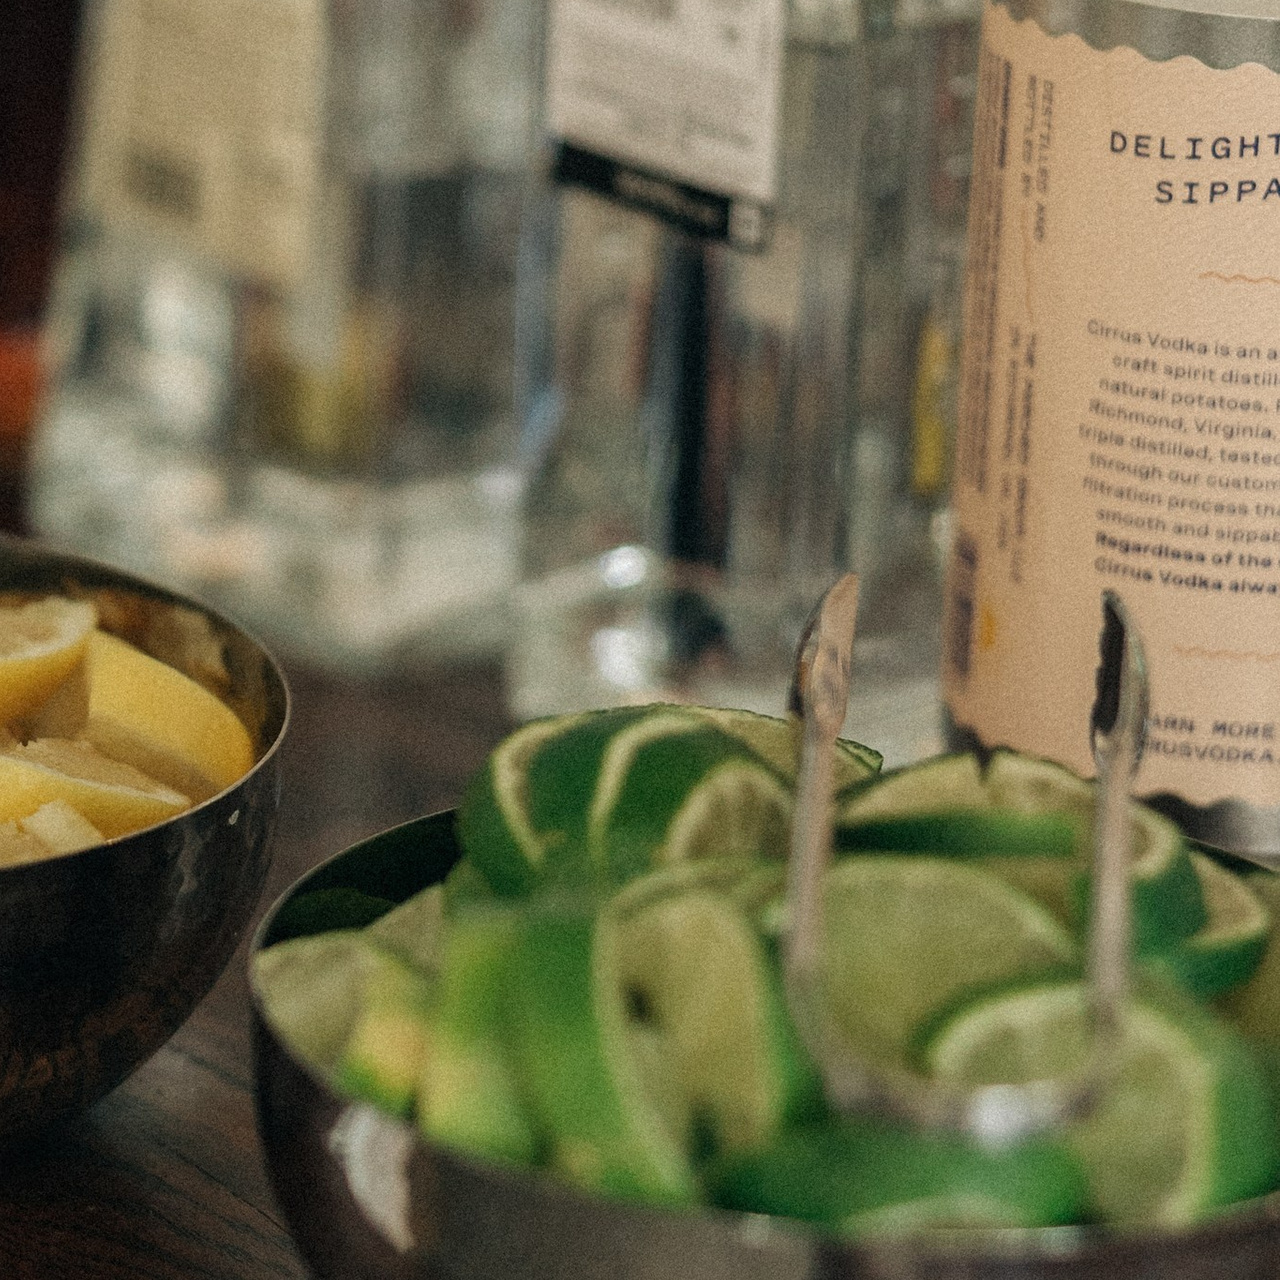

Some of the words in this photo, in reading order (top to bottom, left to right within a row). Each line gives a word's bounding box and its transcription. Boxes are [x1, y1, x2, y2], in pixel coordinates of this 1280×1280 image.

[1154, 177, 1280, 205] SIPPA
[1086, 320, 1142, 345] Cirrus
[1147, 331, 1208, 355] Vodka
[1214, 341, 1230, 357] is
[1236, 346, 1261, 359] an
[1111, 354, 1158, 373] craft
[1163, 364, 1215, 383] spirit
[1099, 378, 1166, 402] natural
[1088, 397, 1188, 433] Richmond,
[1078, 422, 1125, 447] triple
[1089, 451, 1163, 481] through
[1168, 470, 1201, 485] our
[1082, 475, 1163, 505] filtration
[1168, 494, 1249, 516] process
[1096, 508, 1167, 532] smooth
[1172, 523, 1210, 538] and
[1095, 529, 1207, 564] Regardless
[1211, 550, 1234, 566] of
[1237, 553, 1273, 568] the
[1094, 555, 1153, 582] Cirrus
[1158, 570, 1223, 591] Vodka
